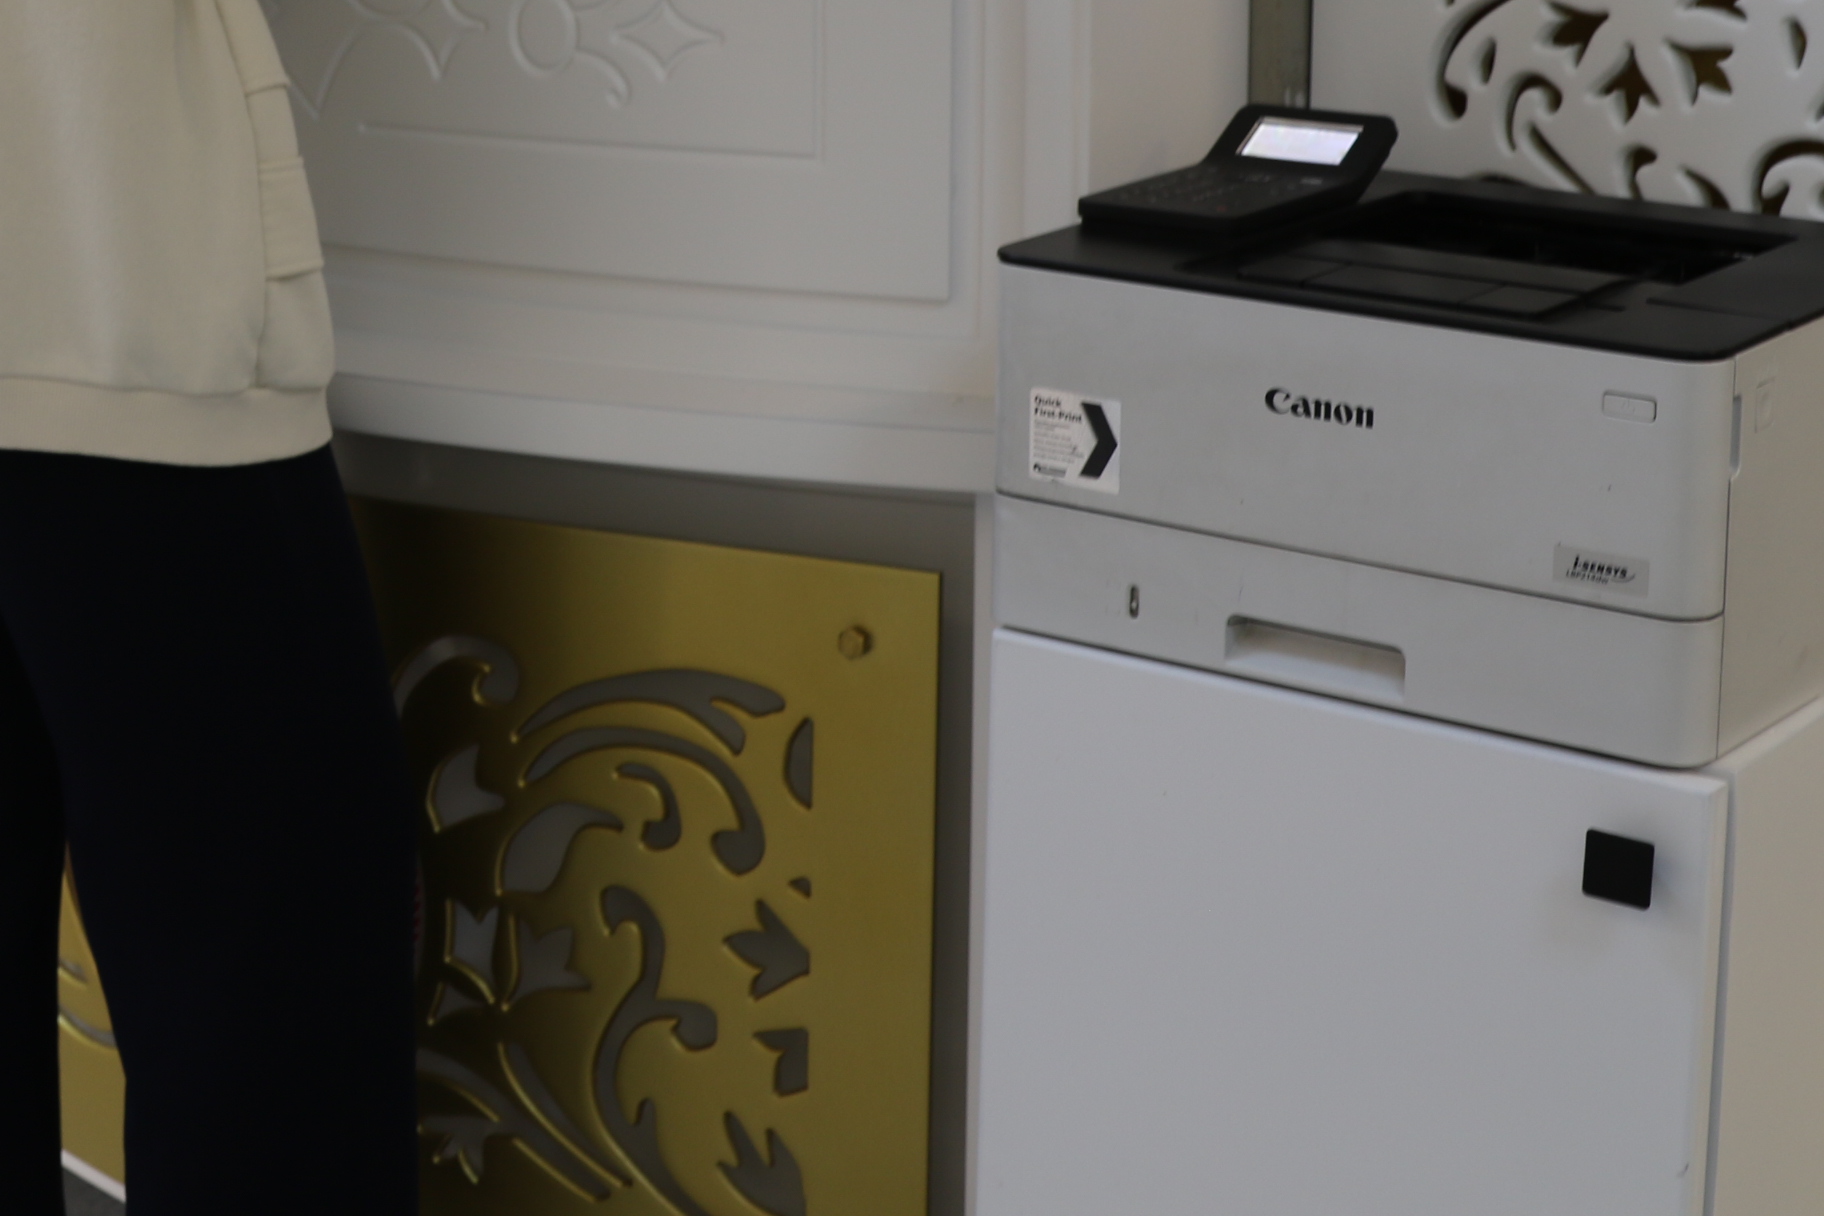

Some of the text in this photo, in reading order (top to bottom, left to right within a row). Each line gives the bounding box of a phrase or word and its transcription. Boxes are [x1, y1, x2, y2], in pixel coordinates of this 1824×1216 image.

[1034, 394, 1061, 407] Quick
[1264, 386, 1375, 430] Canon
[1034, 408, 1082, 423] First-Print
